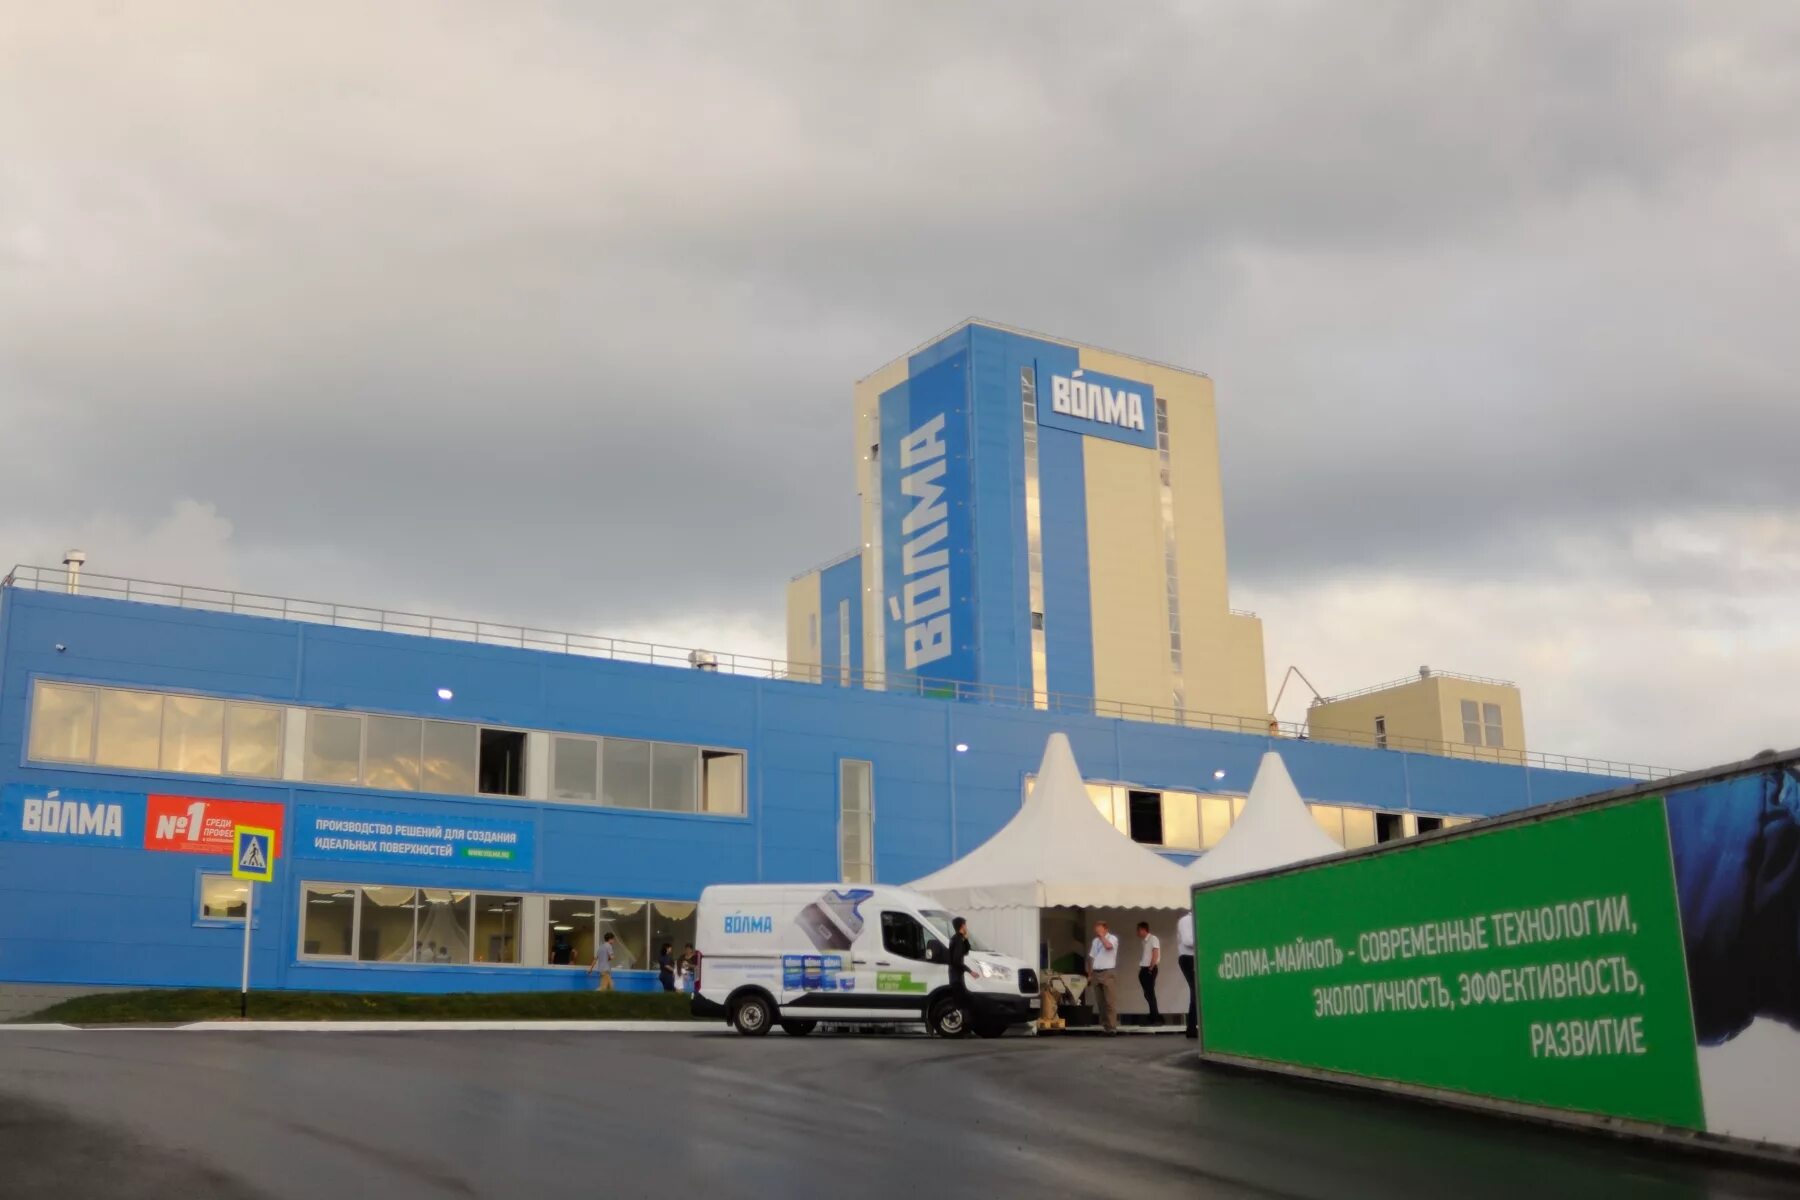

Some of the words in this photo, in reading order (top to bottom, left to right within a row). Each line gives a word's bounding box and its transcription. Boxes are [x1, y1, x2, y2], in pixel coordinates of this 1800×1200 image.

[203, 828, 234, 838] ПРОФЕС
[205, 818, 232, 828] СРЕДИ
[316, 819, 393, 835] ПРОИЗВОДСТВО
[395, 824, 442, 838] РЕШЕНИЙ
[444, 829, 464, 841] ДЛЯ
[466, 830, 517, 843] СОЗДАНИЯ
[315, 837, 377, 852] ИДЕАЛЬНЫХ
[379, 841, 452, 857] ПОВЕРХНОСТЕЙ
[1218, 937, 1343, 980] «ВОЛМА-МАЙКОП»
[1359, 916, 1488, 963] СОВРЕМЕННЫЕ
[1491, 895, 1637, 947] ТЕХНОЛОГИИ,
[1313, 976, 1455, 1017] ЭКОЛОГИЧНОСТЬ,
[1458, 956, 1645, 1006] ЭФФЕКТИВНОСТЬ,
[1531, 1016, 1647, 1057] РАЗВИТИЕ
